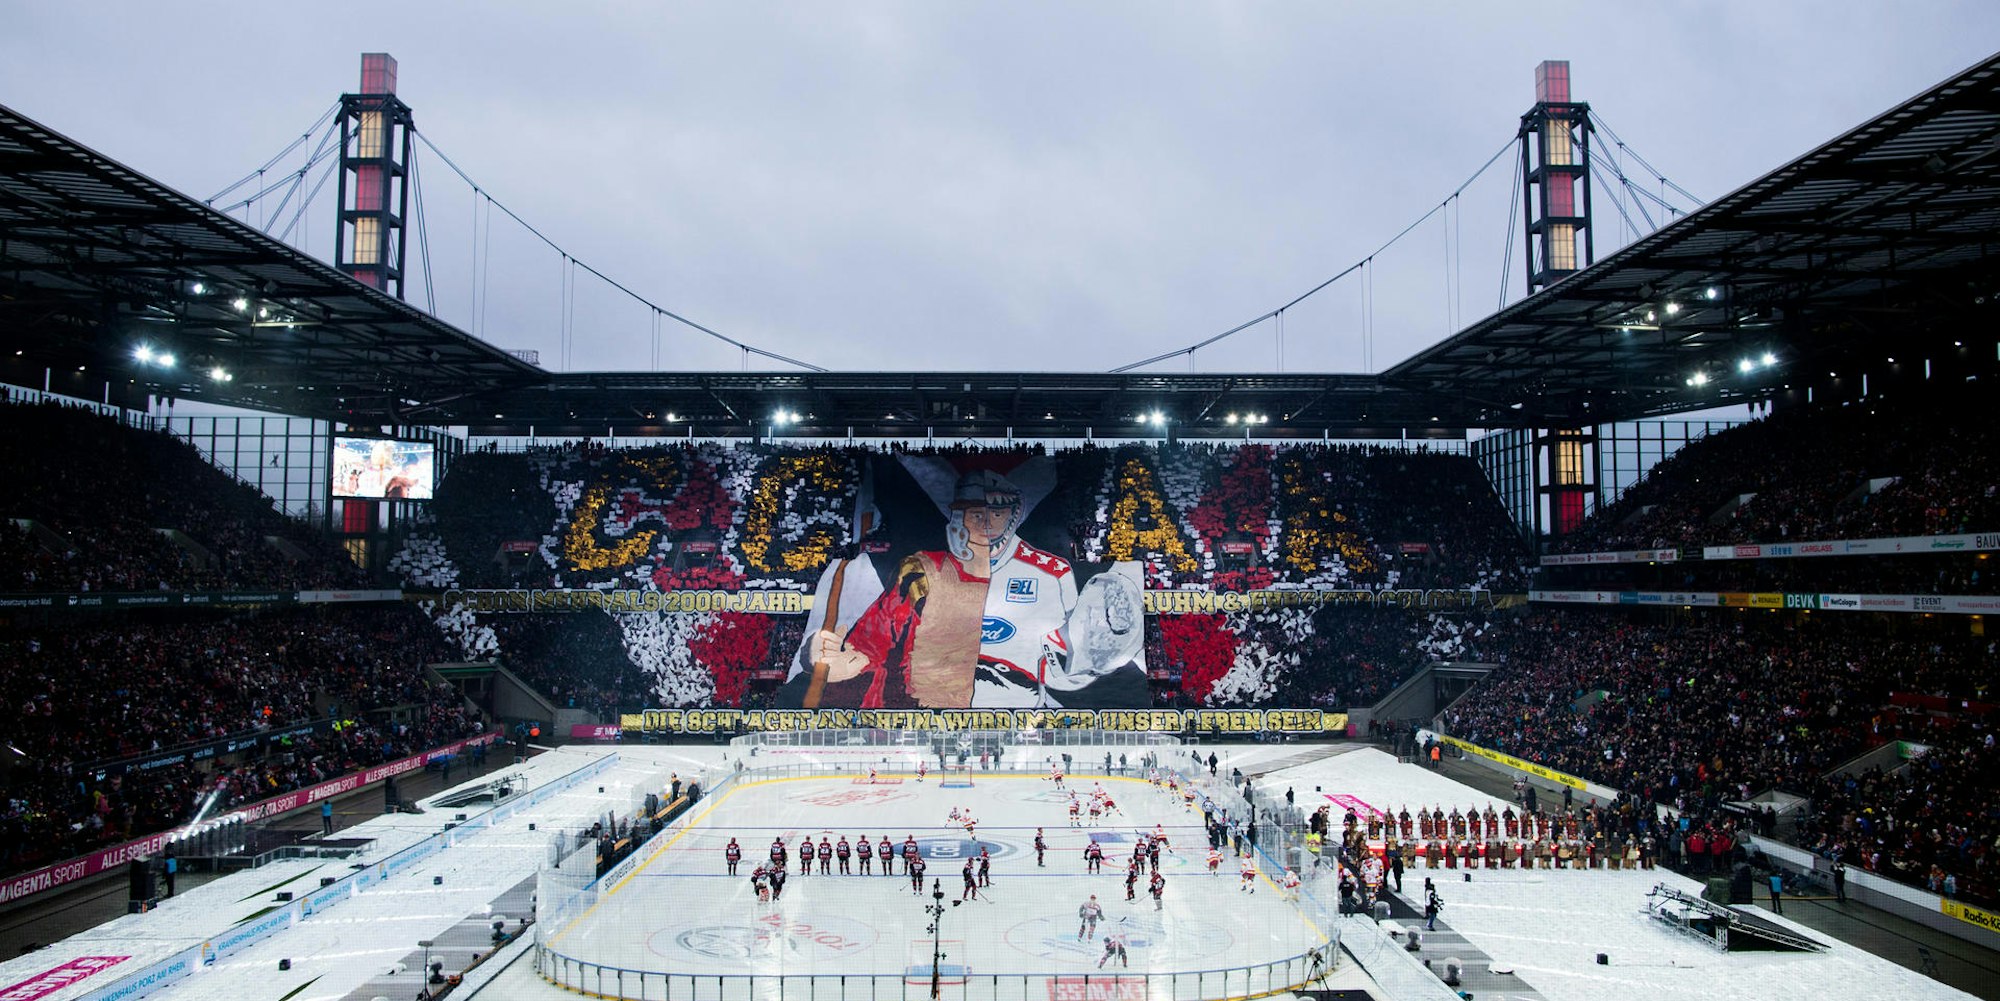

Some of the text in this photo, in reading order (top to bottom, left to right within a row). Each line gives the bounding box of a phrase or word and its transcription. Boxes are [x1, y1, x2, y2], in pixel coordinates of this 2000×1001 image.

[612, 591, 660, 613] ALS
[665, 591, 728, 613] 2000
[732, 591, 802, 613] JAHR
[1144, 591, 1215, 613] RUHM
[1223, 592, 1243, 611] &
[1787, 593, 1815, 608] DEVK
[1921, 597, 1942, 606] EVENT
[644, 711, 682, 732] DIE
[943, 711, 1011, 731] WIRD
[1100, 711, 1181, 731] UNSER
[1266, 711, 1322, 731] SEIN
[246, 795, 297, 824] MAGNTA SPORT
[0, 872, 51, 901] MAGENTA
[54, 861, 87, 885] SPORT
[101, 848, 125, 869] ALLE
[127, 839, 158, 860] SPIELE
[1964, 908, 1989, 926] Radio
[138, 973, 156, 988] PORZ
[156, 970, 167, 982] AM
[168, 962, 186, 976] RHEIN
